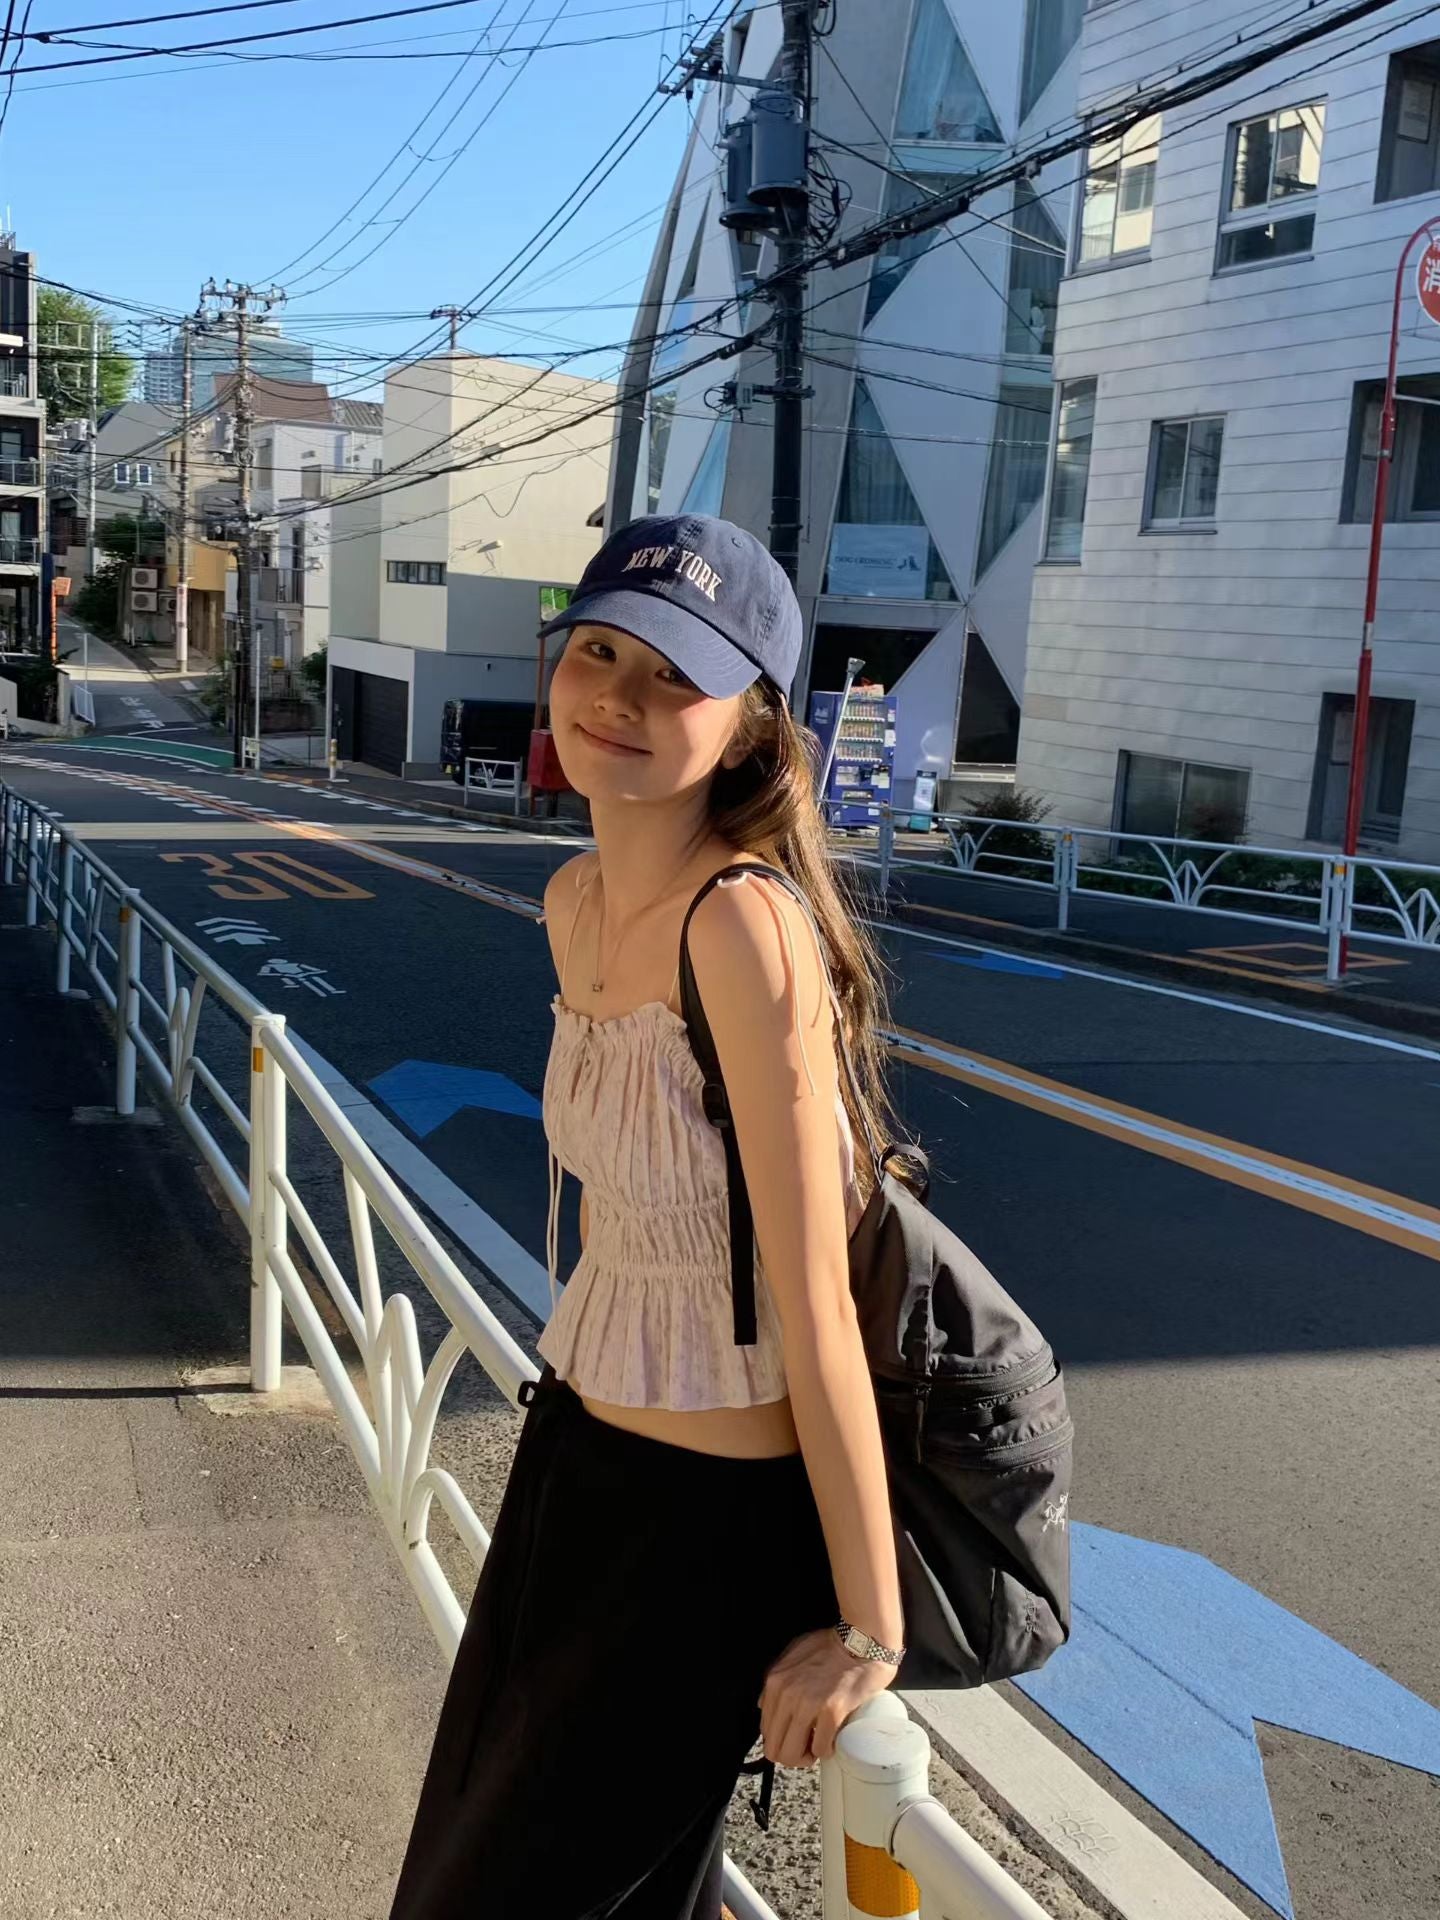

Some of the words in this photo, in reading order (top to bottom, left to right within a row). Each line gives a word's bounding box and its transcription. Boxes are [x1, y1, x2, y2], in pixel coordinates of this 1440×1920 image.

[621, 546, 675, 573] NEW
[674, 549, 723, 602] YORK
[158, 851, 377, 900] 30
